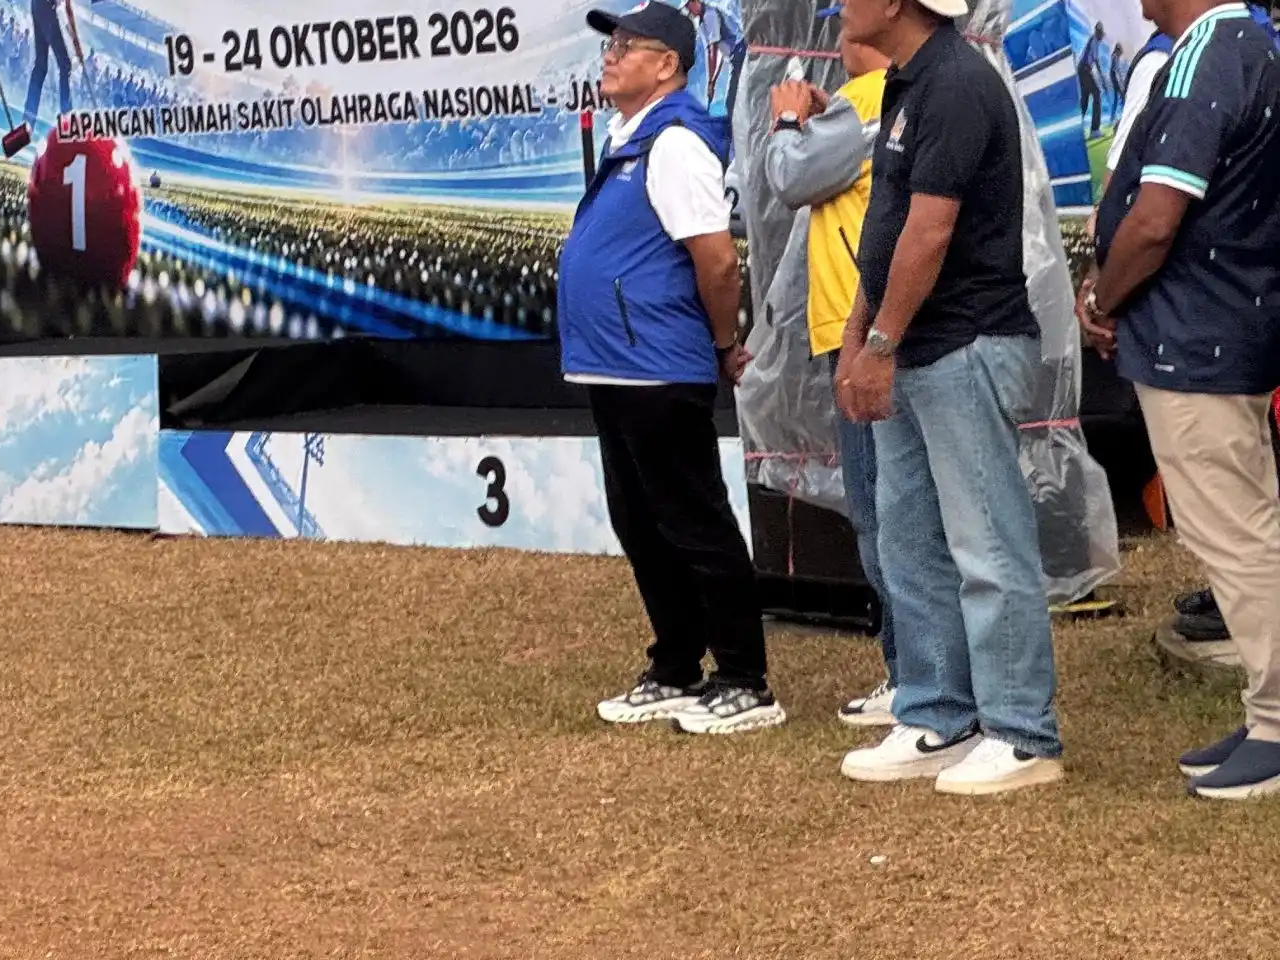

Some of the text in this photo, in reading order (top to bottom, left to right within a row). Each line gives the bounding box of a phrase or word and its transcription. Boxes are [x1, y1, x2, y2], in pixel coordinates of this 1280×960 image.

[164, 33, 194, 77] 19
[222, 27, 262, 72] 24
[269, 14, 420, 67] OKTOBER
[427, 7, 519, 57] 2026
[57, 105, 158, 141] LAPANGAN
[161, 101, 233, 135] RUMAH
[238, 97, 295, 131] SAKIT
[300, 90, 419, 127] OLAHRAGA
[423, 82, 541, 119] NASIONAL
[62, 154, 87, 252] 1
[476, 455, 510, 527] 3
